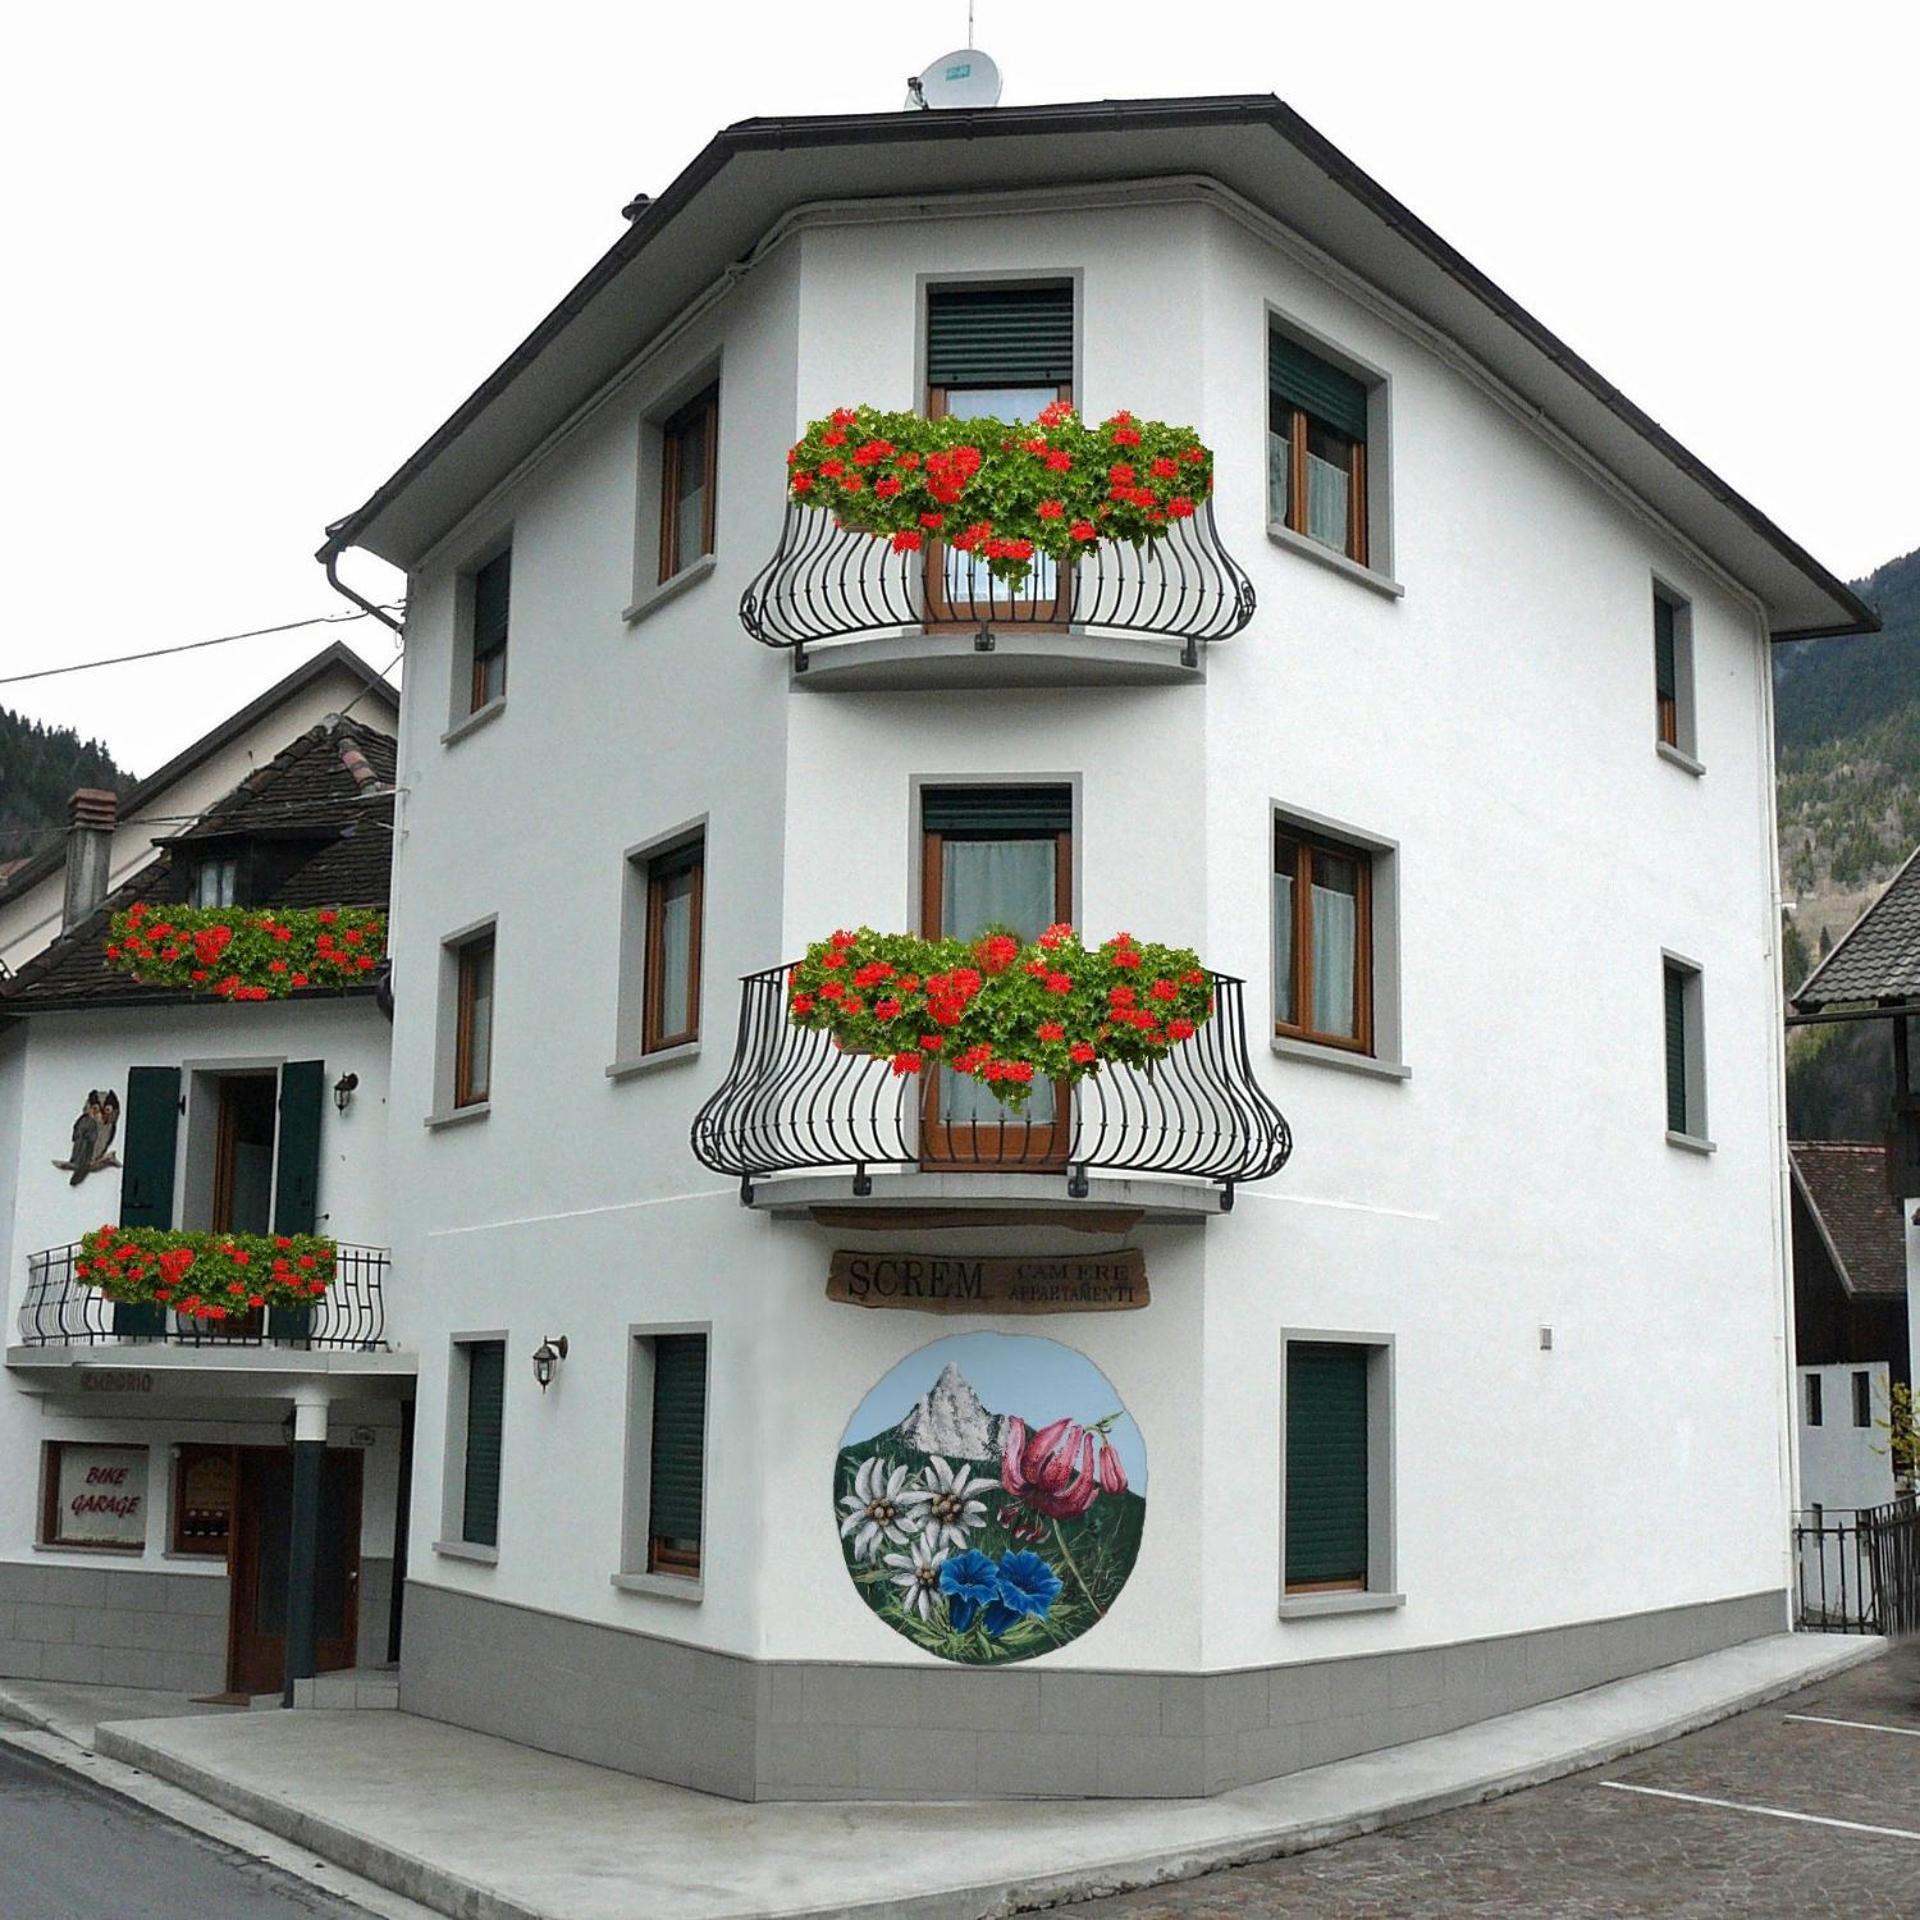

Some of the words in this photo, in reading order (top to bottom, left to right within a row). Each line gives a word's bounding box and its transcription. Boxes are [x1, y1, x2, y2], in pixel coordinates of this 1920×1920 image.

[1017, 1264, 1129, 1281] CAMERE
[86, 1466, 128, 1484] BIKE
[71, 1494, 140, 1518] GARAGE
